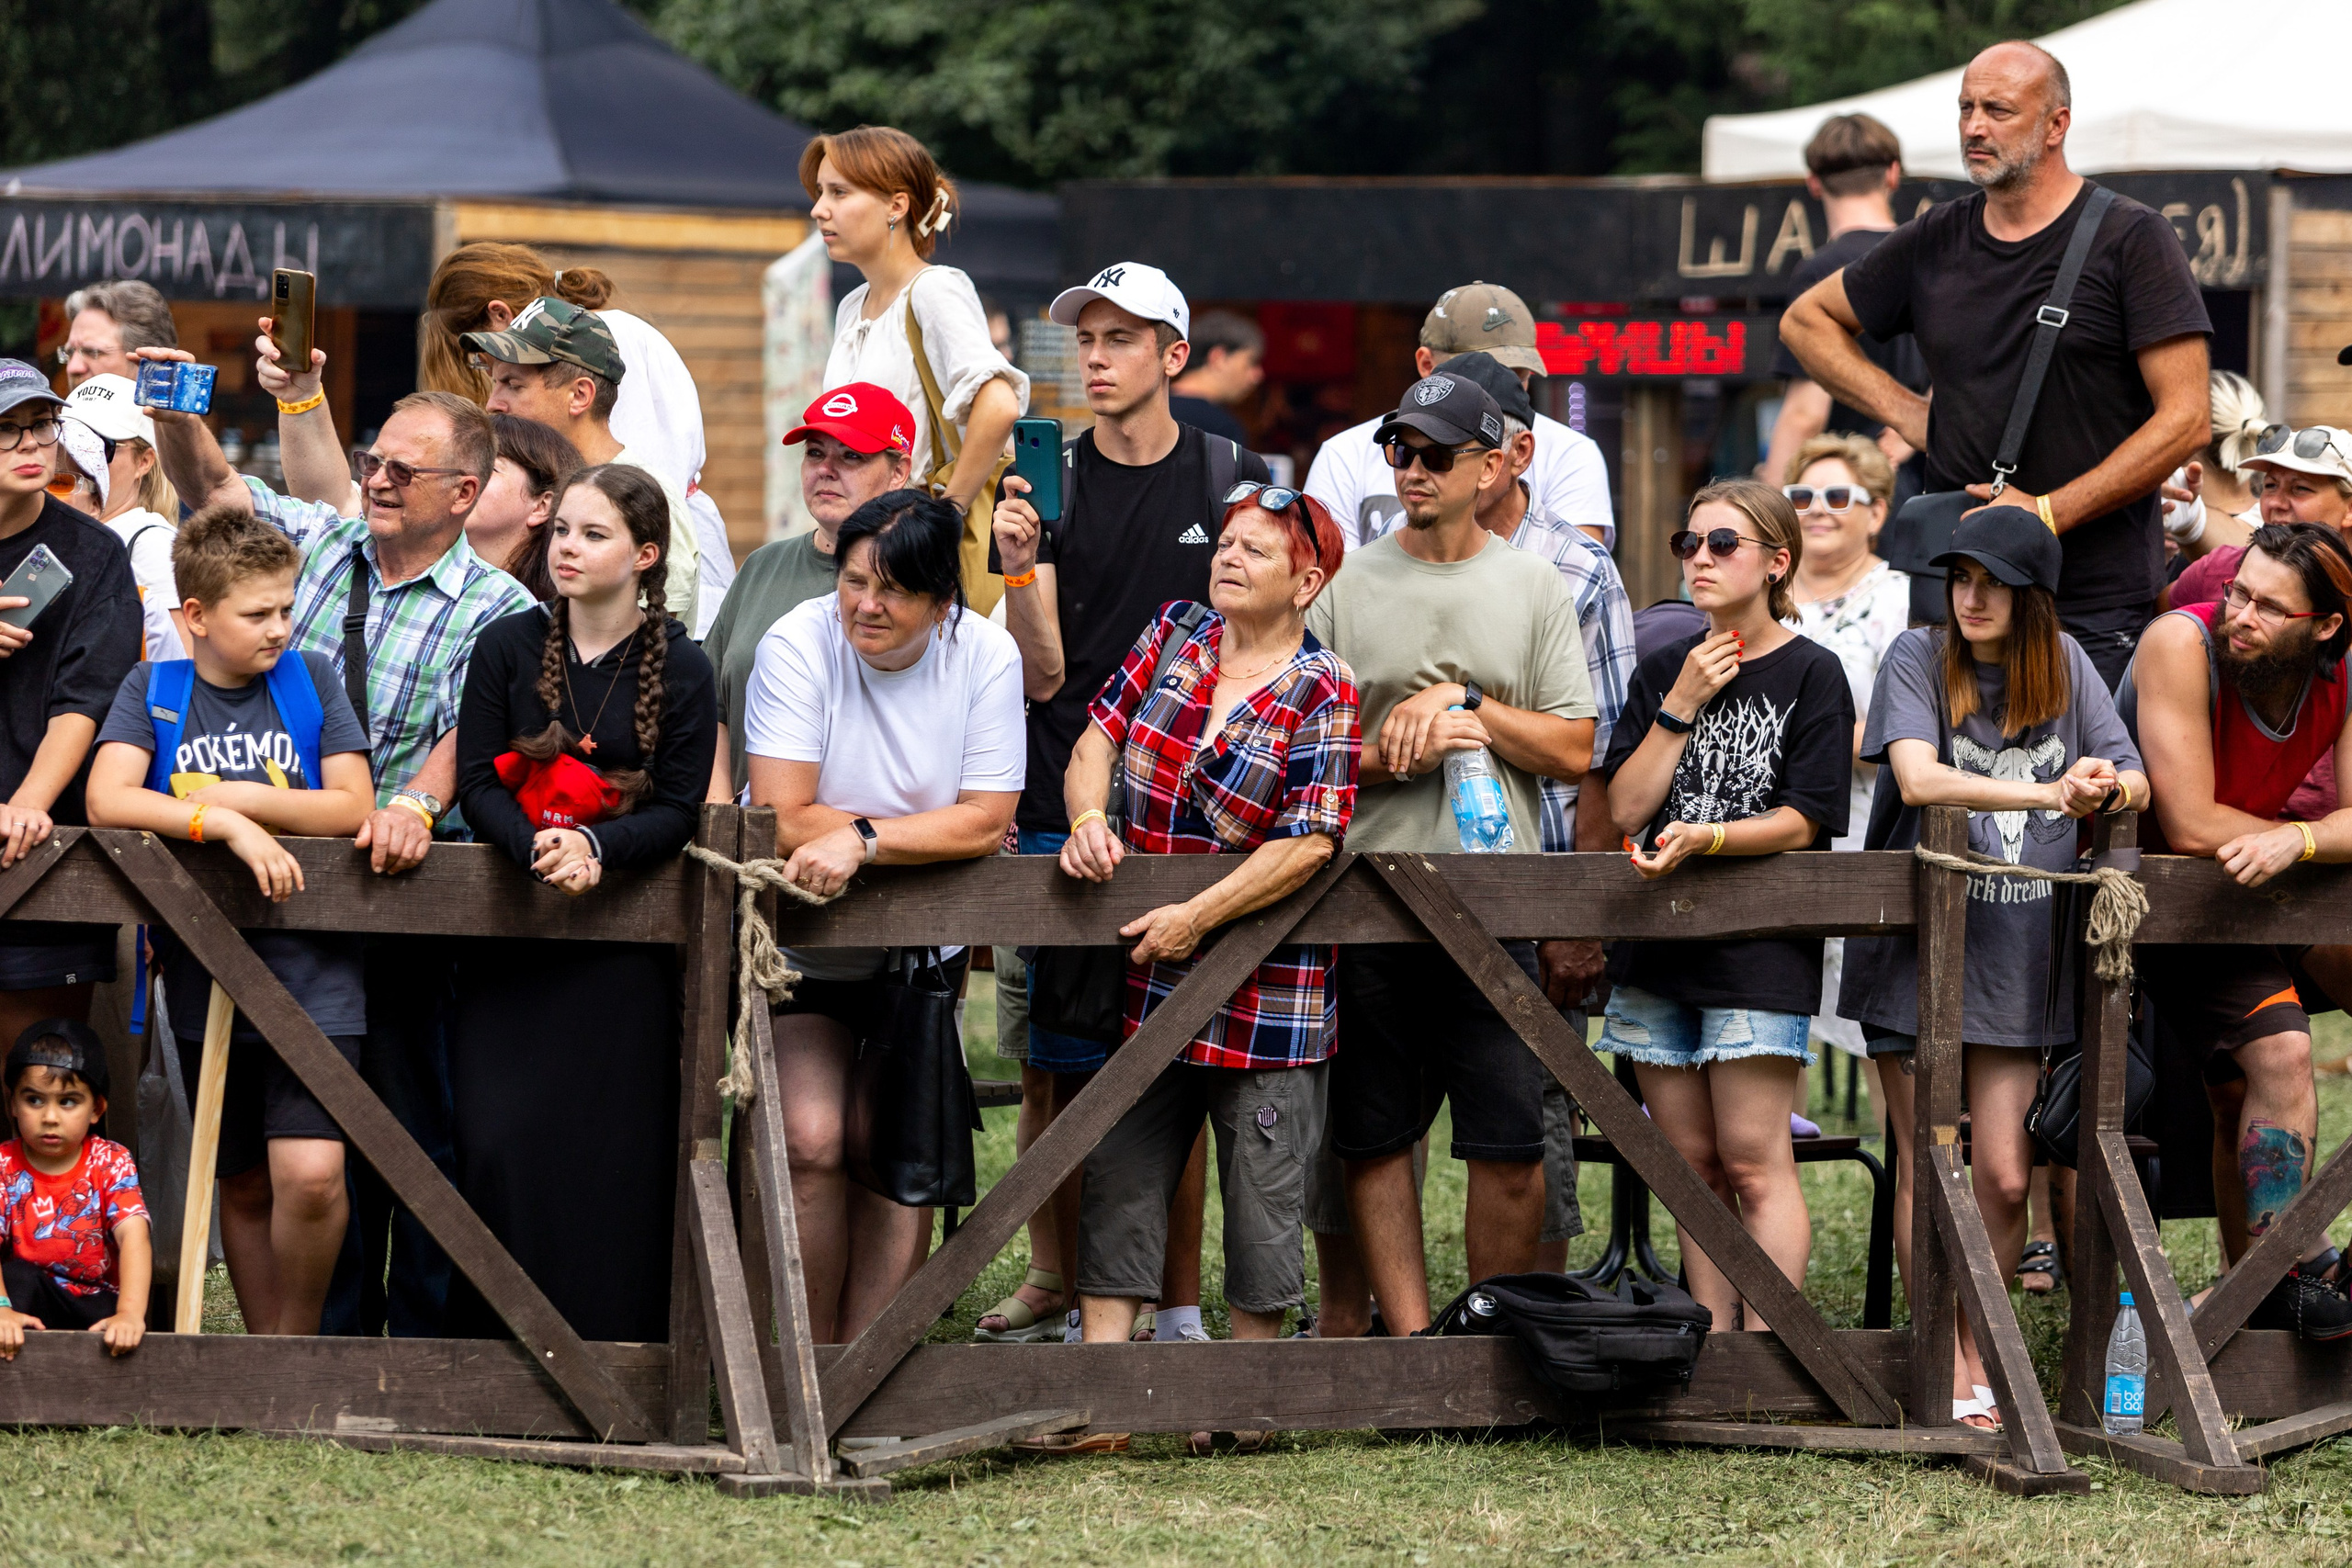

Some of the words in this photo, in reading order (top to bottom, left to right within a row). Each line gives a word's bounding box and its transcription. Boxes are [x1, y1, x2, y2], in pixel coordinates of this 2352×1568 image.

[76, 385, 116, 401] YOUTH
[1178, 536, 1209, 545] adidas
[1741, 791, 1752, 814] thing
